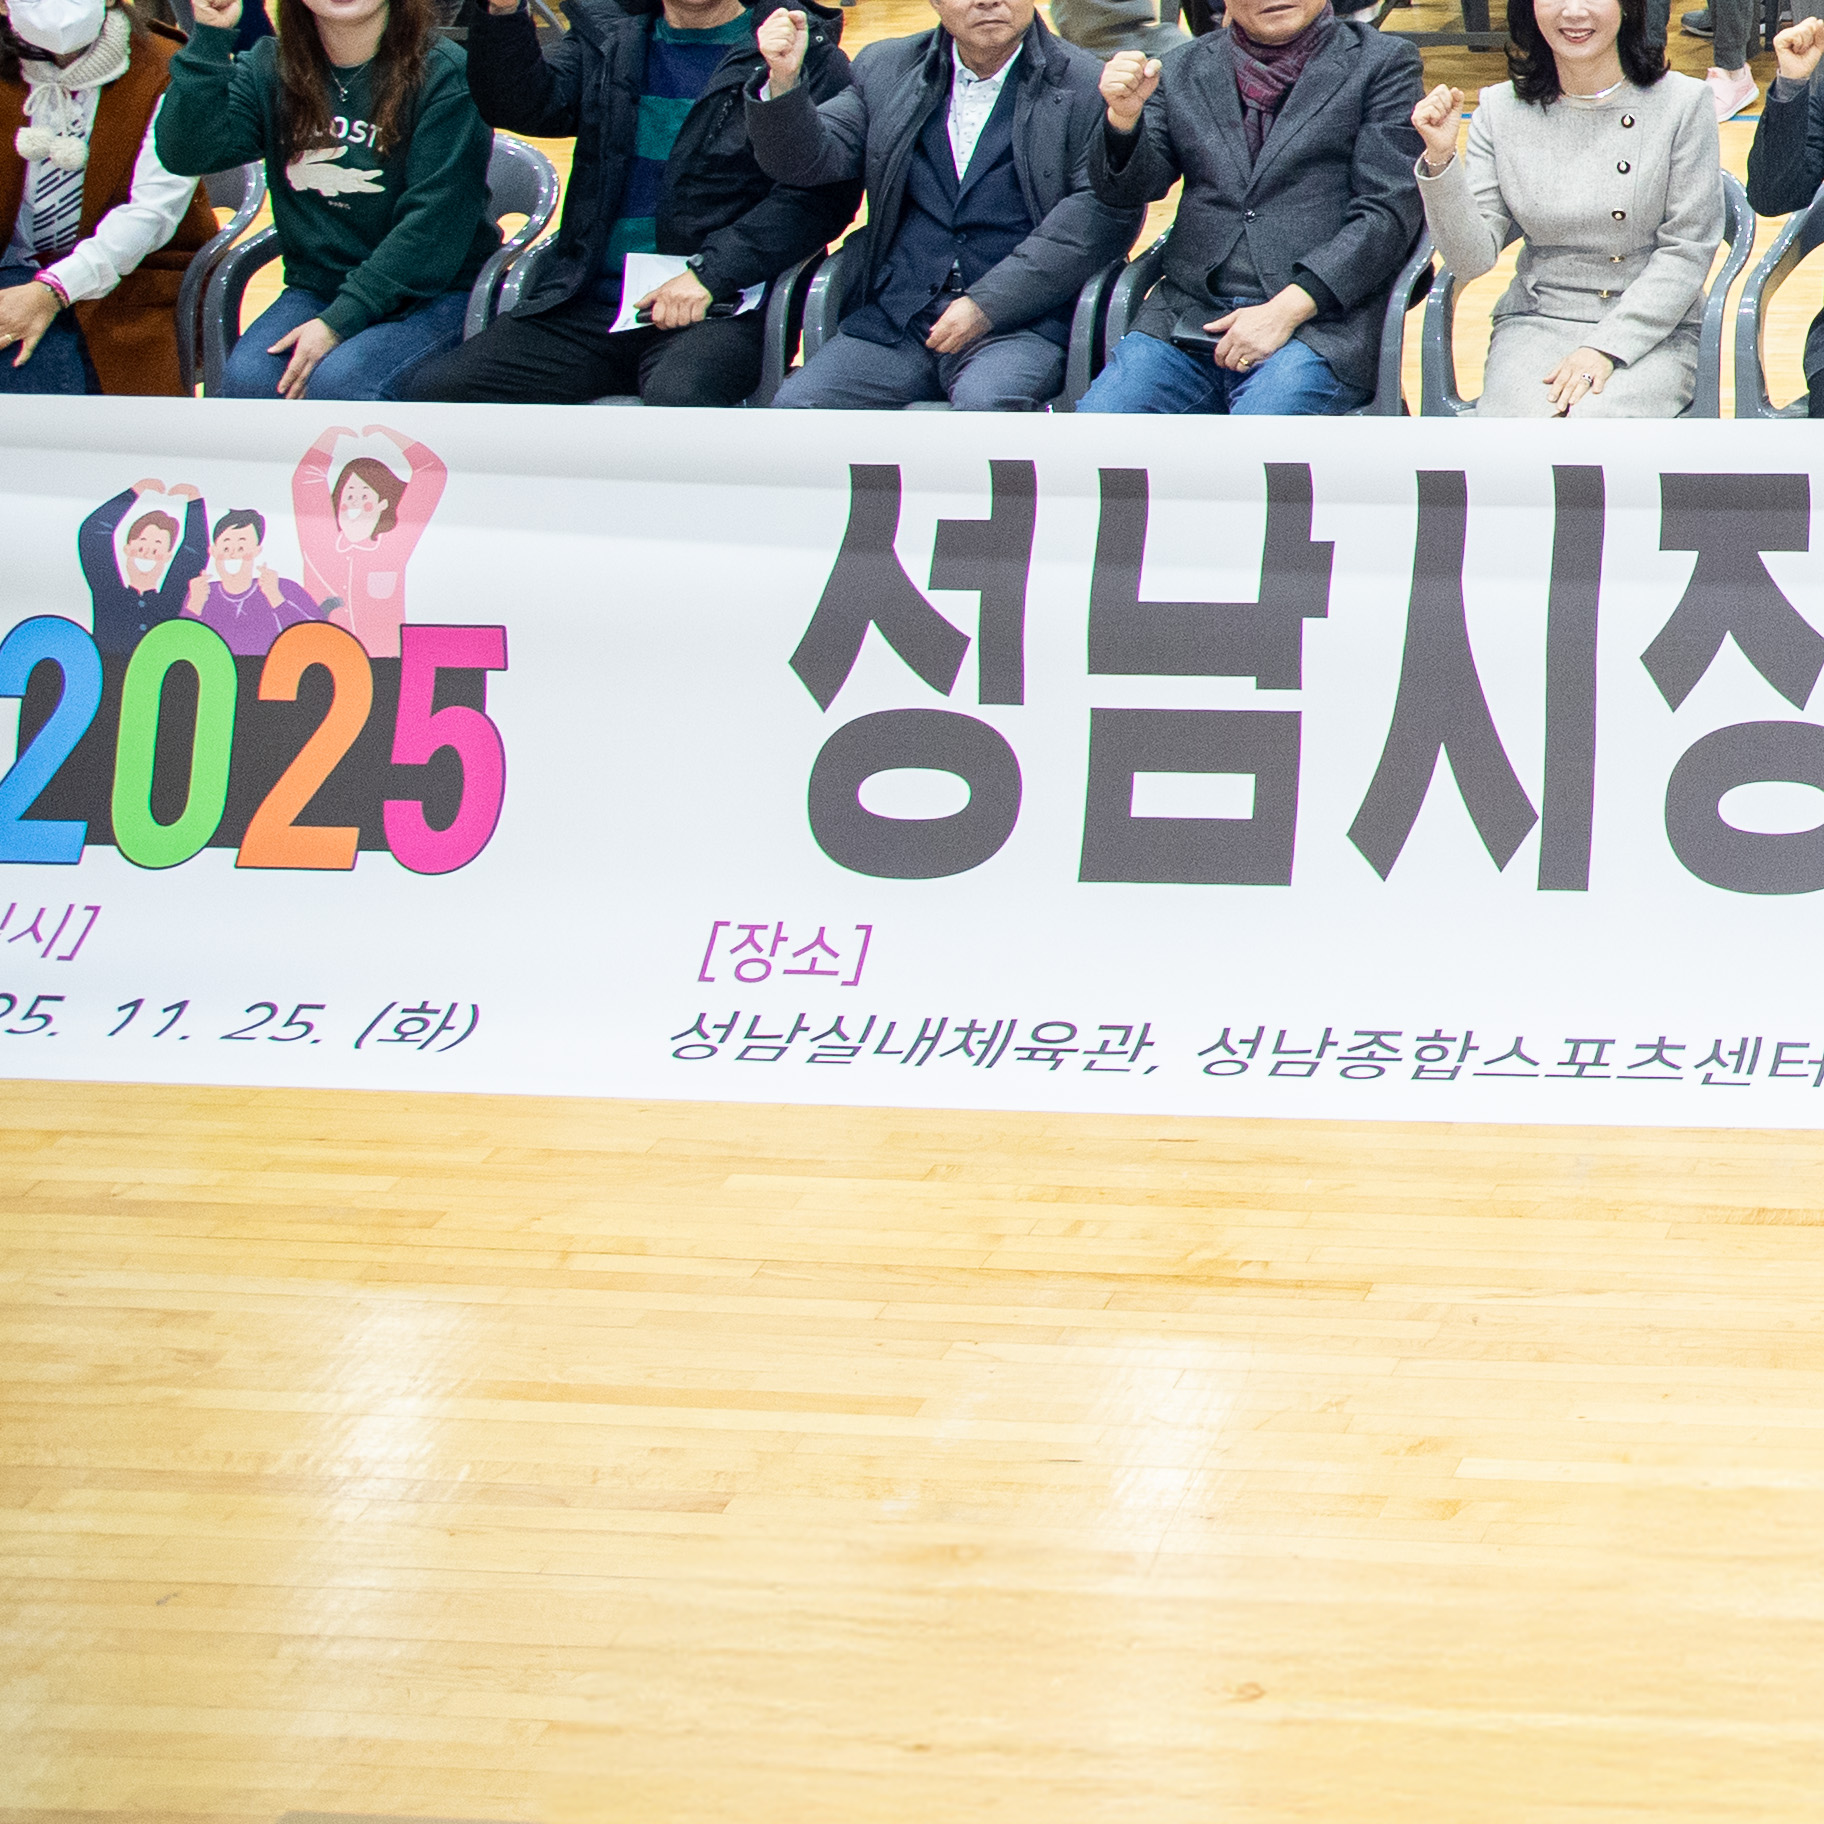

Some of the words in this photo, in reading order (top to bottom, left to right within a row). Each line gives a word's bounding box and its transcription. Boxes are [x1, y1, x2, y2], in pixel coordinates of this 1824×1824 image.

[0, 613, 508, 876] 2025
[698, 920, 873, 987] [장소]
[0, 992, 66, 1037] 5.
[107, 997, 191, 1041] 11.
[219, 1001, 327, 1045] 25.
[353, 1000, 480, 1053] (화)
[669, 1010, 1158, 1077] 성남실내체육관,
